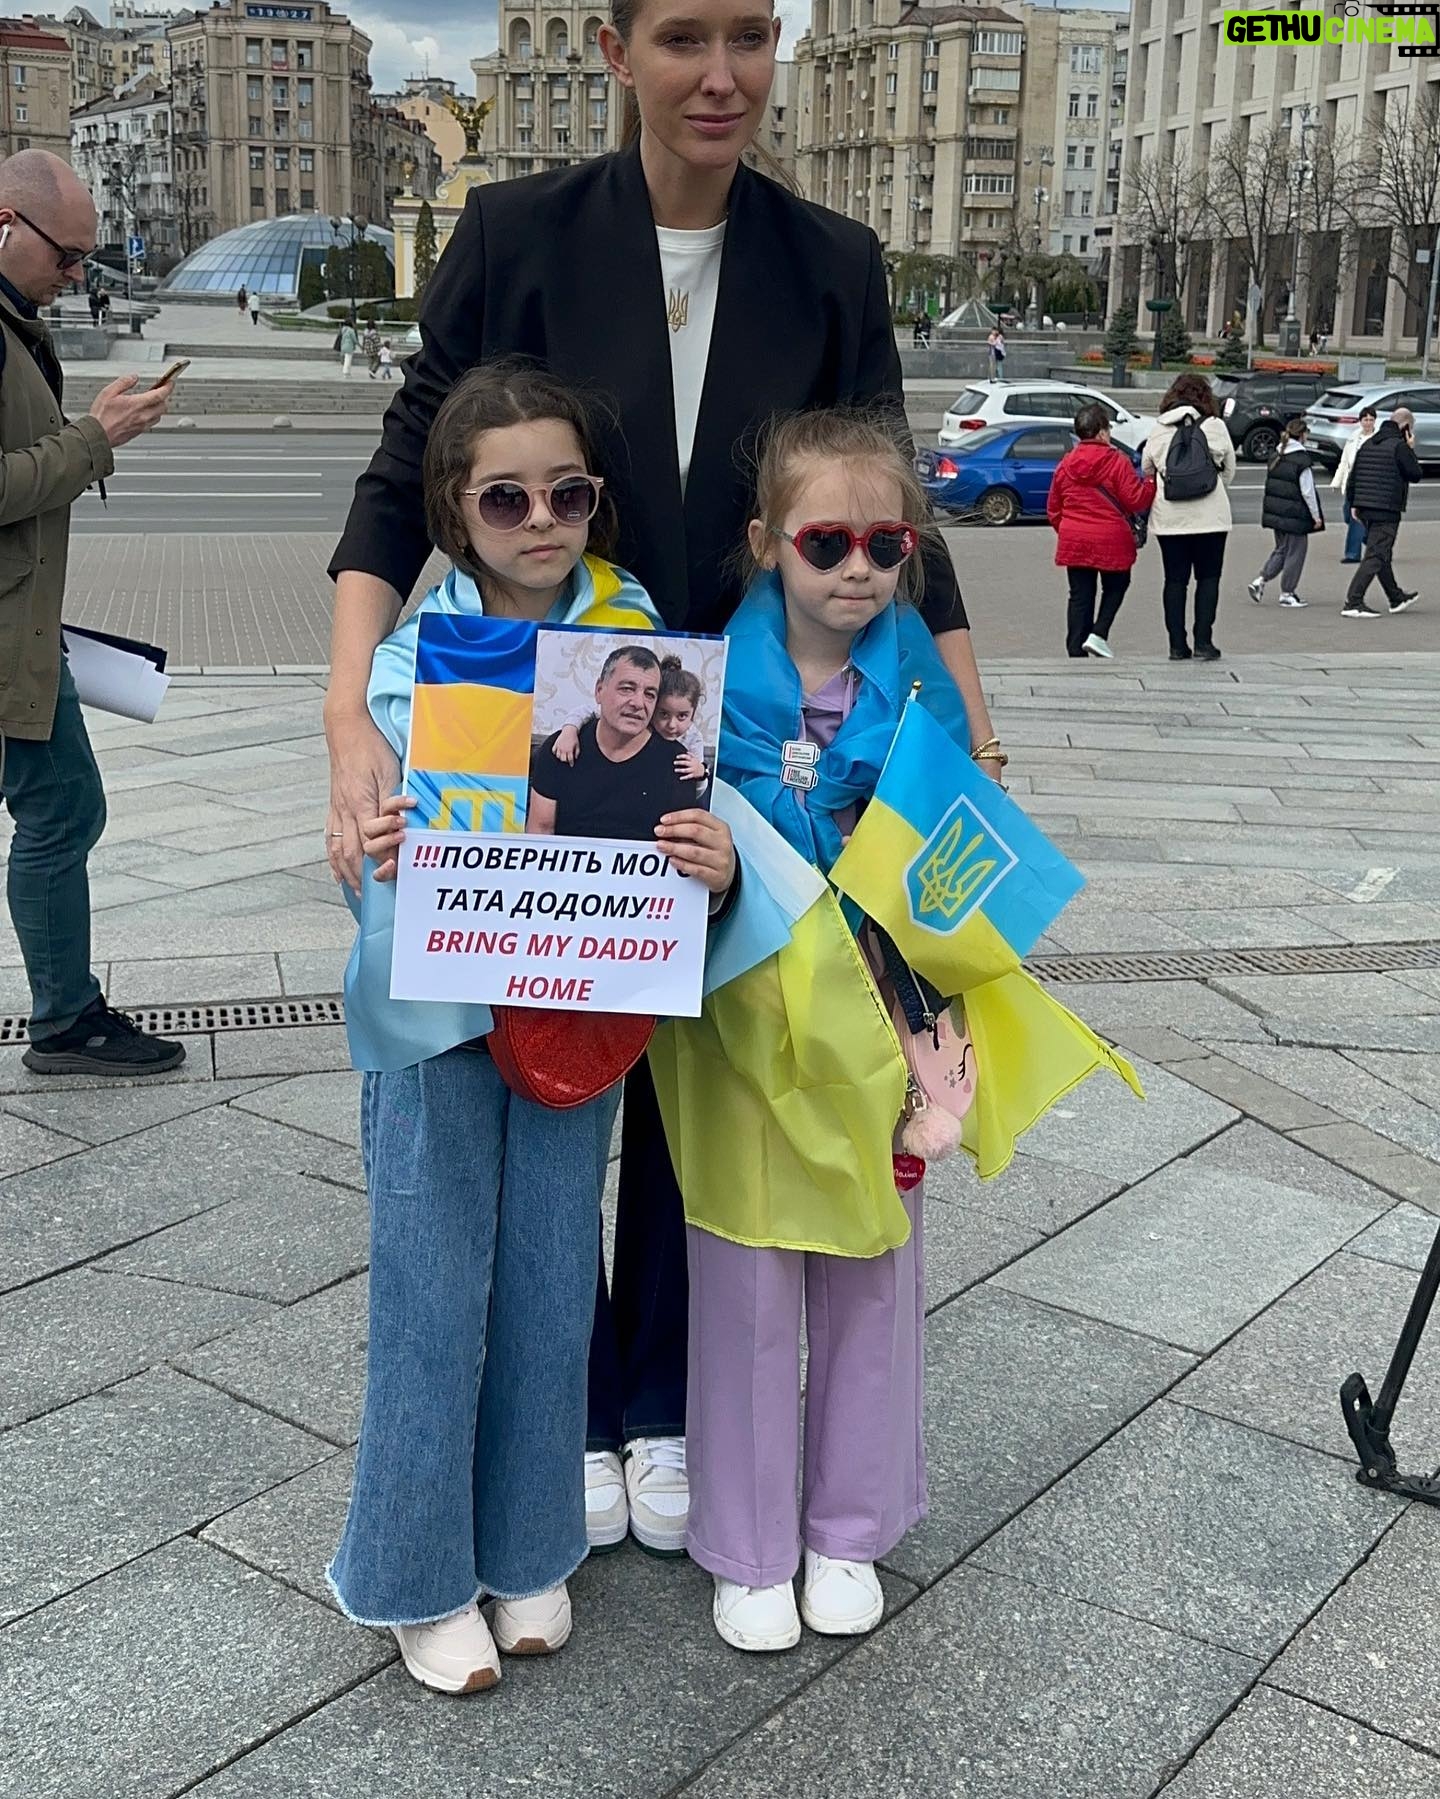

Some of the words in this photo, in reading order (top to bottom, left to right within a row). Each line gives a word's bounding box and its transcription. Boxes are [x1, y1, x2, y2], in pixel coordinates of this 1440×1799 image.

[413, 845, 602, 874] !!!ПОВЕРНІТЬ
[611, 852, 692, 878] МОГ
[437, 888, 504, 912] ТАТА
[509, 891, 675, 921] ДОДОМУ!!!
[426, 930, 518, 955] BRING
[526, 934, 573, 958] MY
[578, 936, 679, 962] DADDY
[506, 975, 595, 1001] HOME
